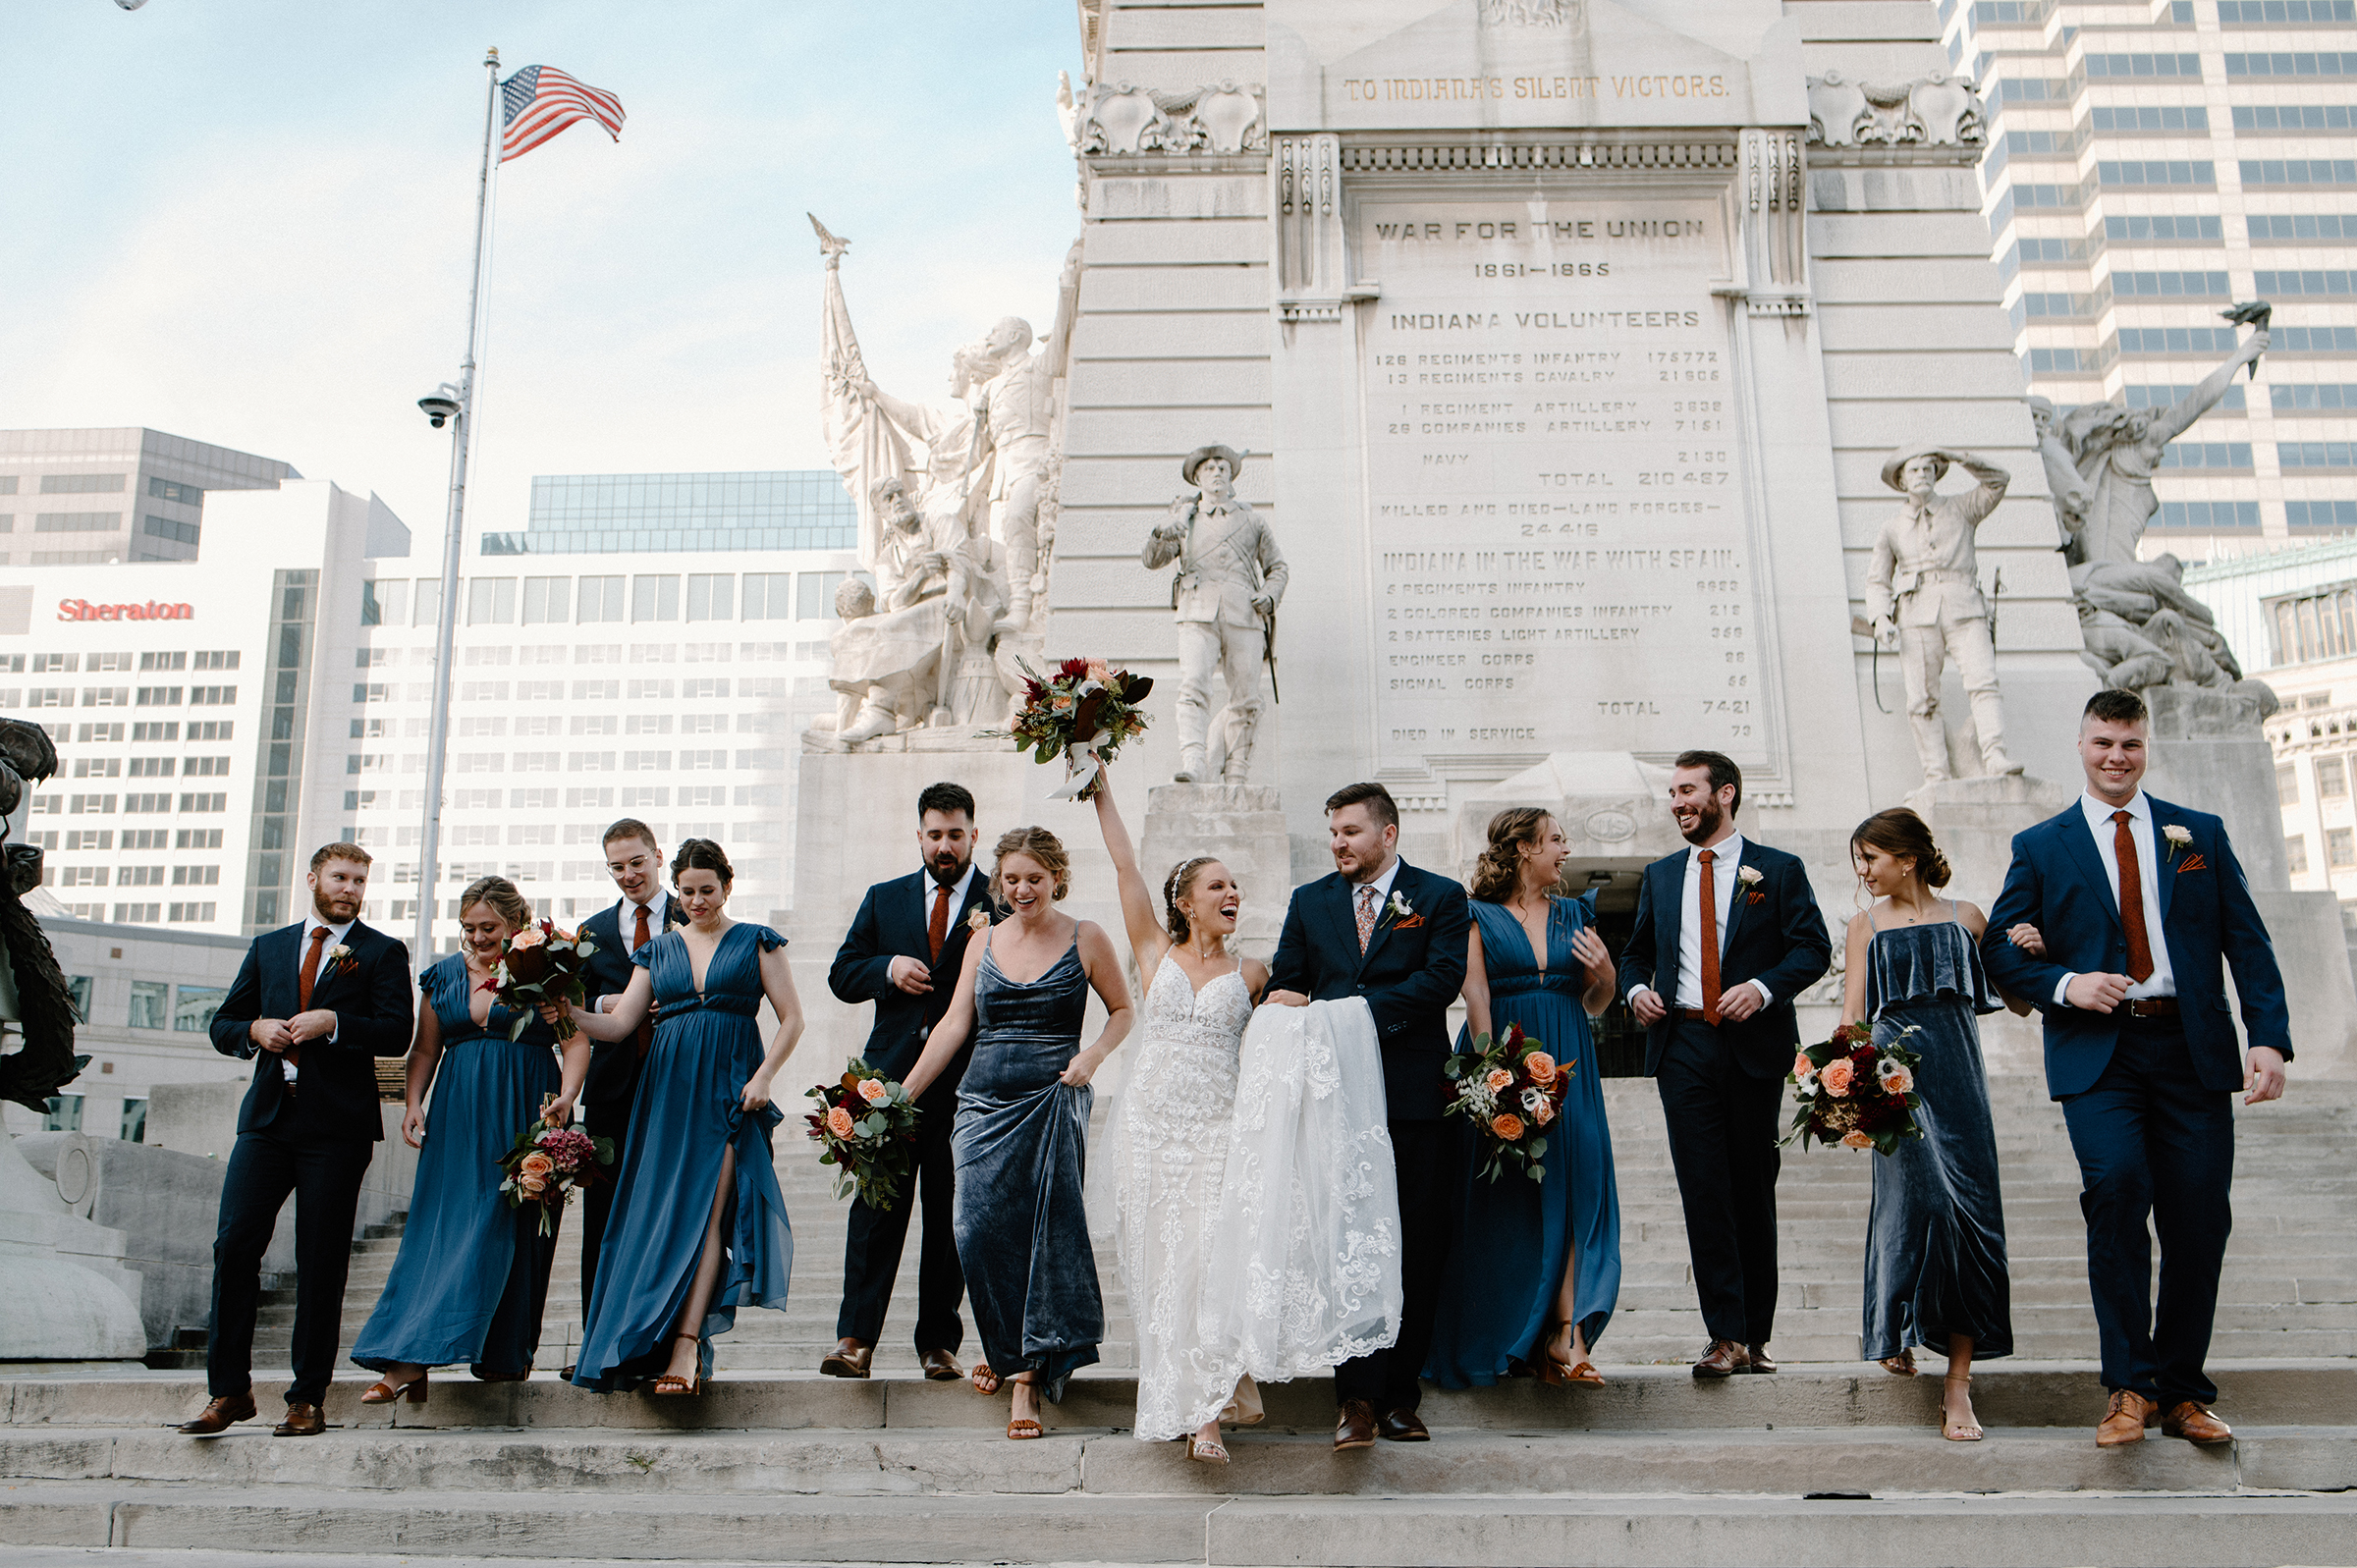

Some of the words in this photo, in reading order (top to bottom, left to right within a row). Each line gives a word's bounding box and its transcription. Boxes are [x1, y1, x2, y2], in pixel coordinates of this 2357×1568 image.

[1343, 79, 1378, 101] TO
[1513, 77, 1601, 99] SILENT
[1611, 76, 1730, 98] VICTORS.
[1376, 222, 1442, 241] WAR
[1455, 222, 1517, 240] FOR
[1531, 221, 1595, 239] THE
[1607, 220, 1705, 238] UNION
[1392, 313, 1502, 330] INDIANA
[1515, 311, 1700, 328] VOLUNTEERS
[1418, 353, 1523, 365] REGIMENTS
[1533, 352, 1621, 364] INFANTRY
[1647, 351, 1719, 364] 175772
[1388, 373, 1408, 385] 13
[1419, 373, 1524, 384] REGIMENTS
[1535, 371, 1616, 383] CAVALRY
[1420, 404, 1514, 415] REGIMENT
[1533, 402, 1637, 414] ARTILLERY
[1421, 422, 1527, 434] COMPANIES
[1547, 420, 1652, 432] ARTILLERY
[1422, 454, 1470, 465] NAVY
[1677, 452, 1727, 462] 2130
[1538, 473, 1615, 487] TOTAL
[1381, 505, 1450, 517] KILLED
[1460, 505, 1497, 516] AND
[1383, 553, 1468, 572] INDIANA
[1477, 553, 1497, 571] IN
[1503, 552, 1547, 571] THE
[1554, 551, 1598, 571] WAR
[1606, 551, 1662, 570] WITH
[1669, 551, 1741, 569] SPAIN.
[1402, 583, 1499, 595] REGIMENTS
[1507, 581, 1586, 594] INFANTRY
[57, 598, 194, 622] Sheraton
[1388, 608, 1398, 620] 2
[1403, 607, 1481, 620] COLORED
[1490, 607, 1583, 619] COMPANIES
[1593, 606, 1673, 618] INFANTRY
[1389, 630, 1398, 642] 2
[1403, 629, 1493, 642] BATTERIES
[1501, 629, 1547, 641] LIGHT
[1554, 628, 1641, 640] ARTILLERY
[1389, 655, 1466, 667] ENGINEER
[1481, 654, 1535, 666] CORPS
[1390, 678, 1447, 690] SIGNAL
[1464, 677, 1515, 689] CORPS
[1597, 701, 1661, 716] TOTAL
[1702, 700, 1751, 715] 7421
[1392, 729, 1427, 740] DIED
[1441, 729, 1456, 740] IN
[1469, 727, 1536, 740] SERVICE
[1730, 726, 1751, 737] 73
